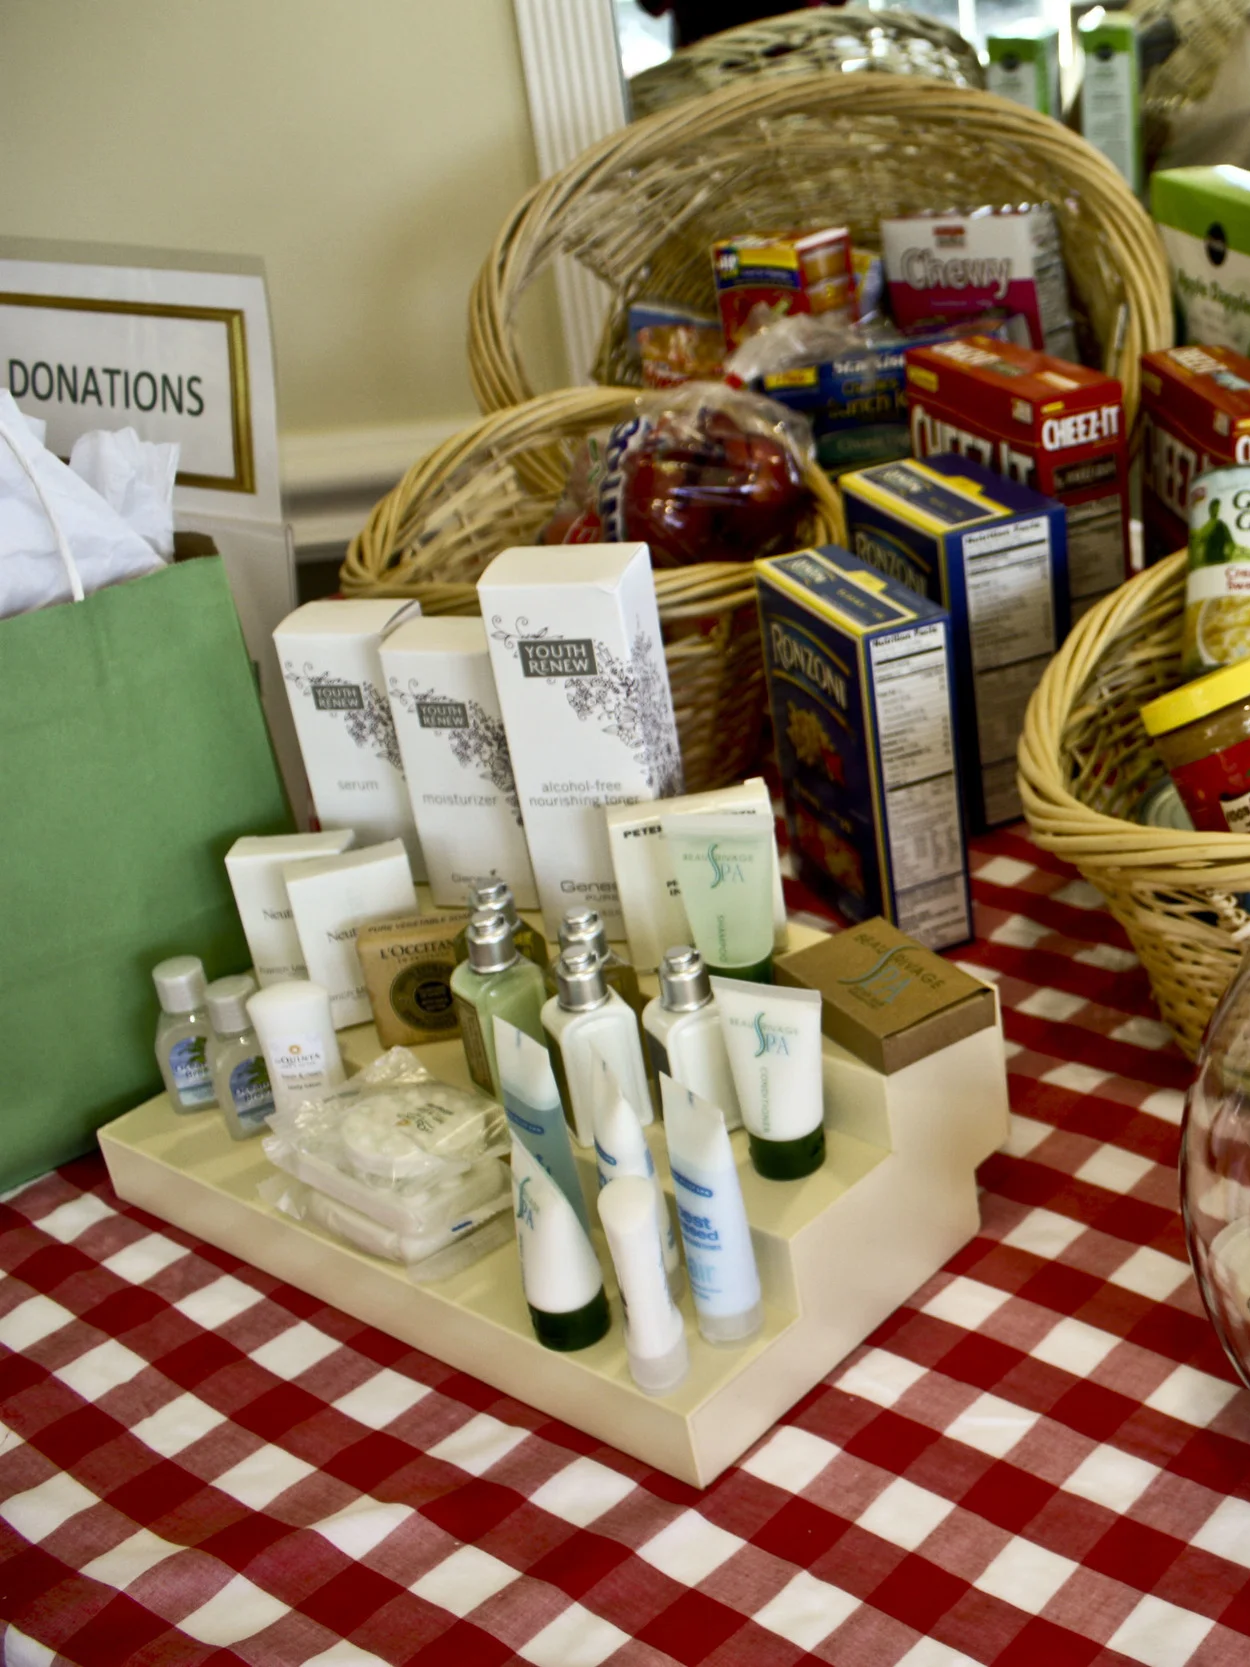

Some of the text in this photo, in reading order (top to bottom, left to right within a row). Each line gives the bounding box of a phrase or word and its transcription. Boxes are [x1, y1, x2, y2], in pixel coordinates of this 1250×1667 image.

[901, 247, 1012, 299] Chewy
[7, 357, 205, 417] DONATIONS
[1042, 404, 1120, 451] CHEEZ-IT
[524, 644, 587, 660] YOUTH
[529, 657, 590, 676] RENEW
[770, 624, 847, 711] RONZONI
[315, 687, 358, 700] YOUTH
[318, 697, 360, 709] RENEW
[420, 705, 462, 717] YOUTH
[423, 715, 464, 727] RENEW
[337, 780, 379, 791] serum
[541, 780, 622, 793] alcohol-free
[422, 792, 499, 807] moisturizer
[529, 793, 639, 808] nourishing toner
[707, 843, 745, 889] SPA
[754, 1012, 790, 1058] SPA
